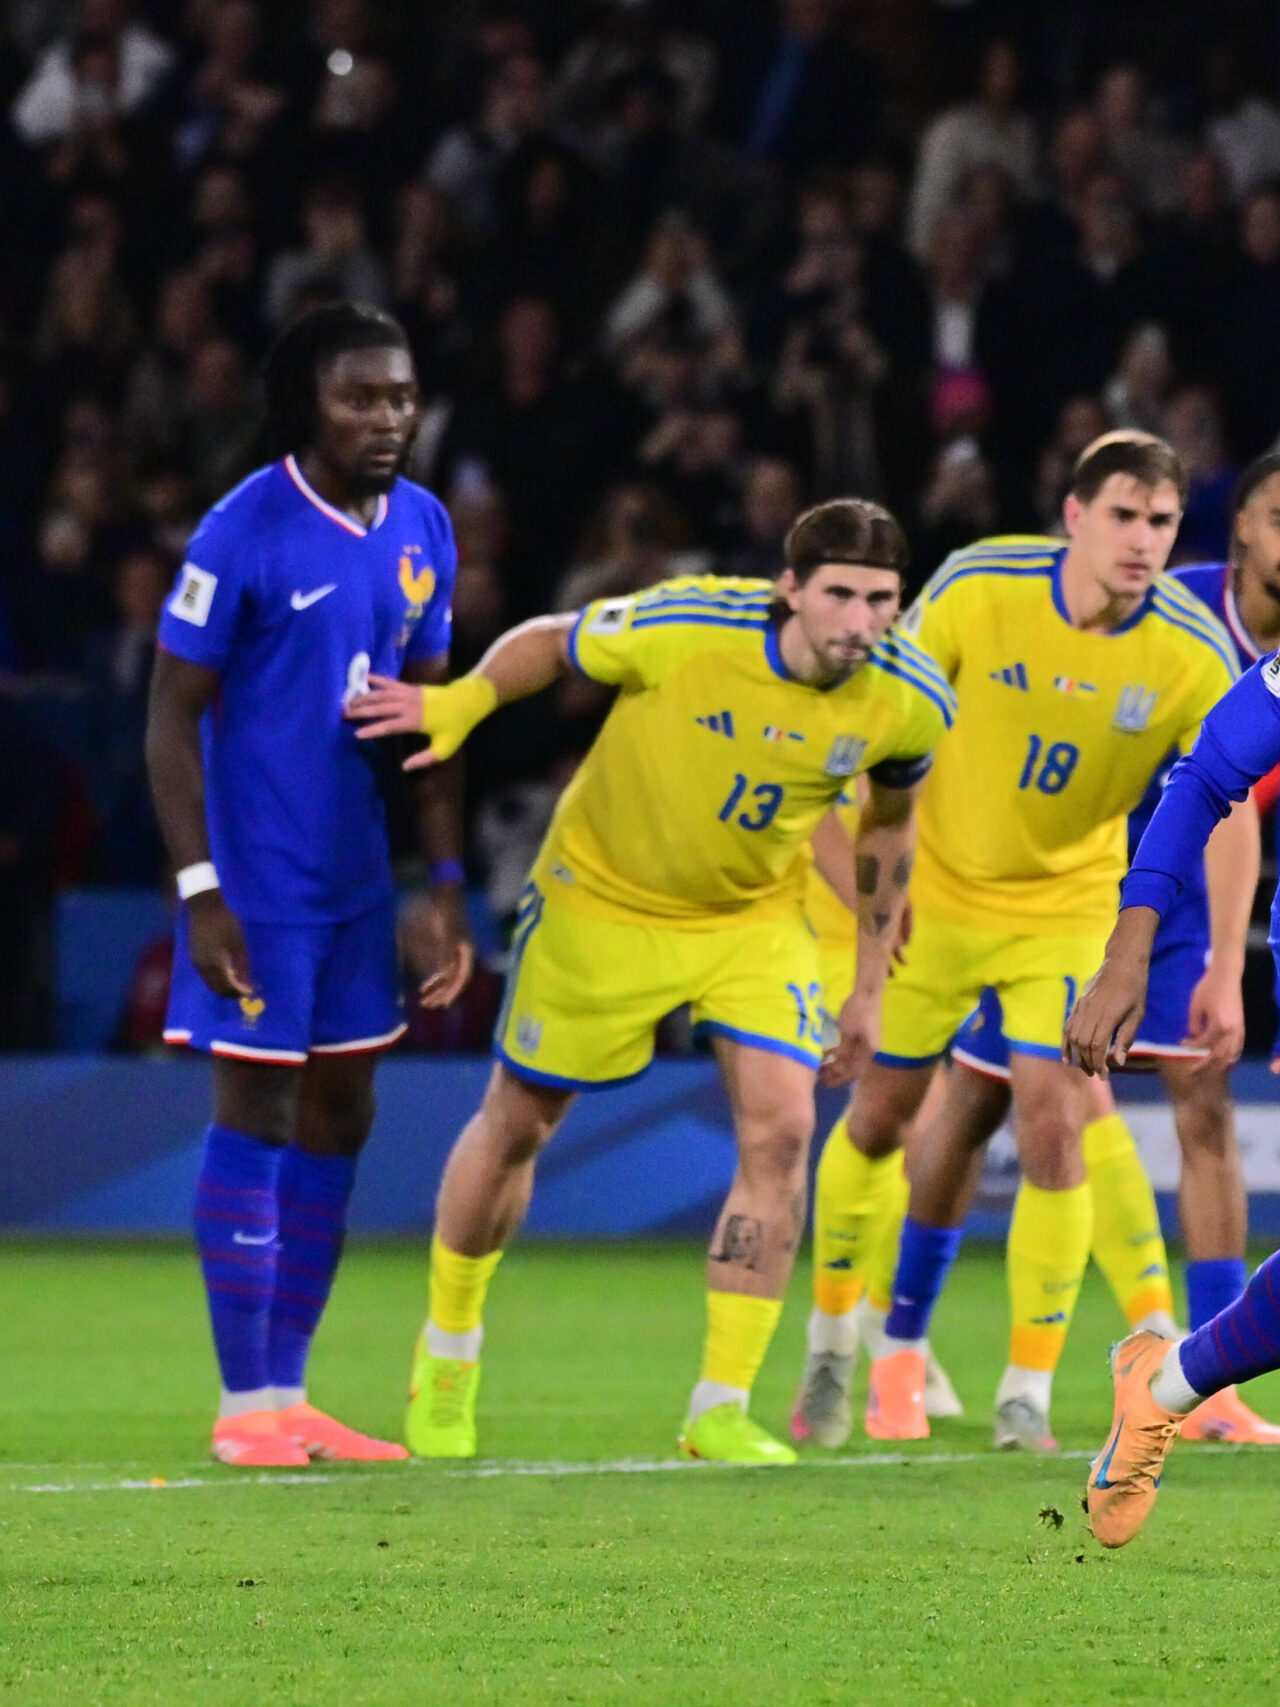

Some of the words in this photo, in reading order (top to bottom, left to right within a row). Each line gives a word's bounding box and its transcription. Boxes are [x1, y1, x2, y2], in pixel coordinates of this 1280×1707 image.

[1018, 733, 1081, 796] 18
[718, 772, 784, 831] 13
[786, 982, 824, 1044] 13
